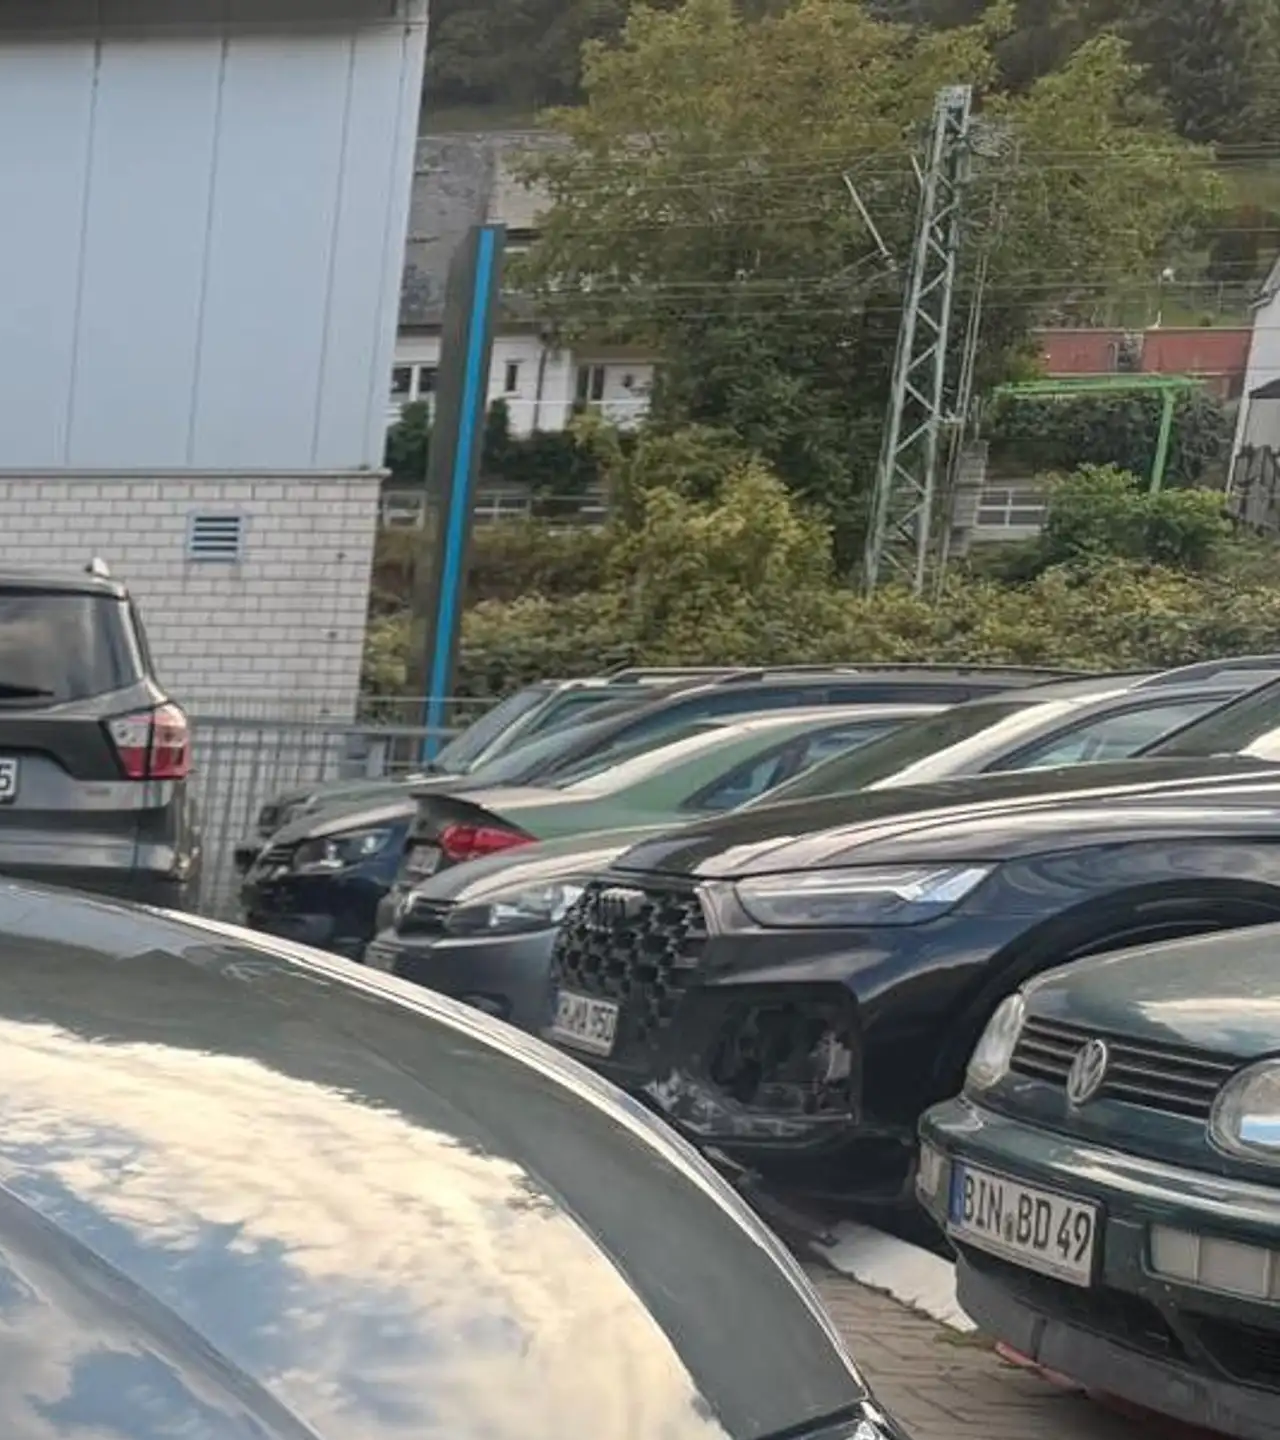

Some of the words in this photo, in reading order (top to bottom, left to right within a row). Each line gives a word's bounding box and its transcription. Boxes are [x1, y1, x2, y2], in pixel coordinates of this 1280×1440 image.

[963, 1174, 1003, 1236] BIN
[1016, 1193, 1052, 1249] BD
[1056, 1206, 1091, 1262] 49
